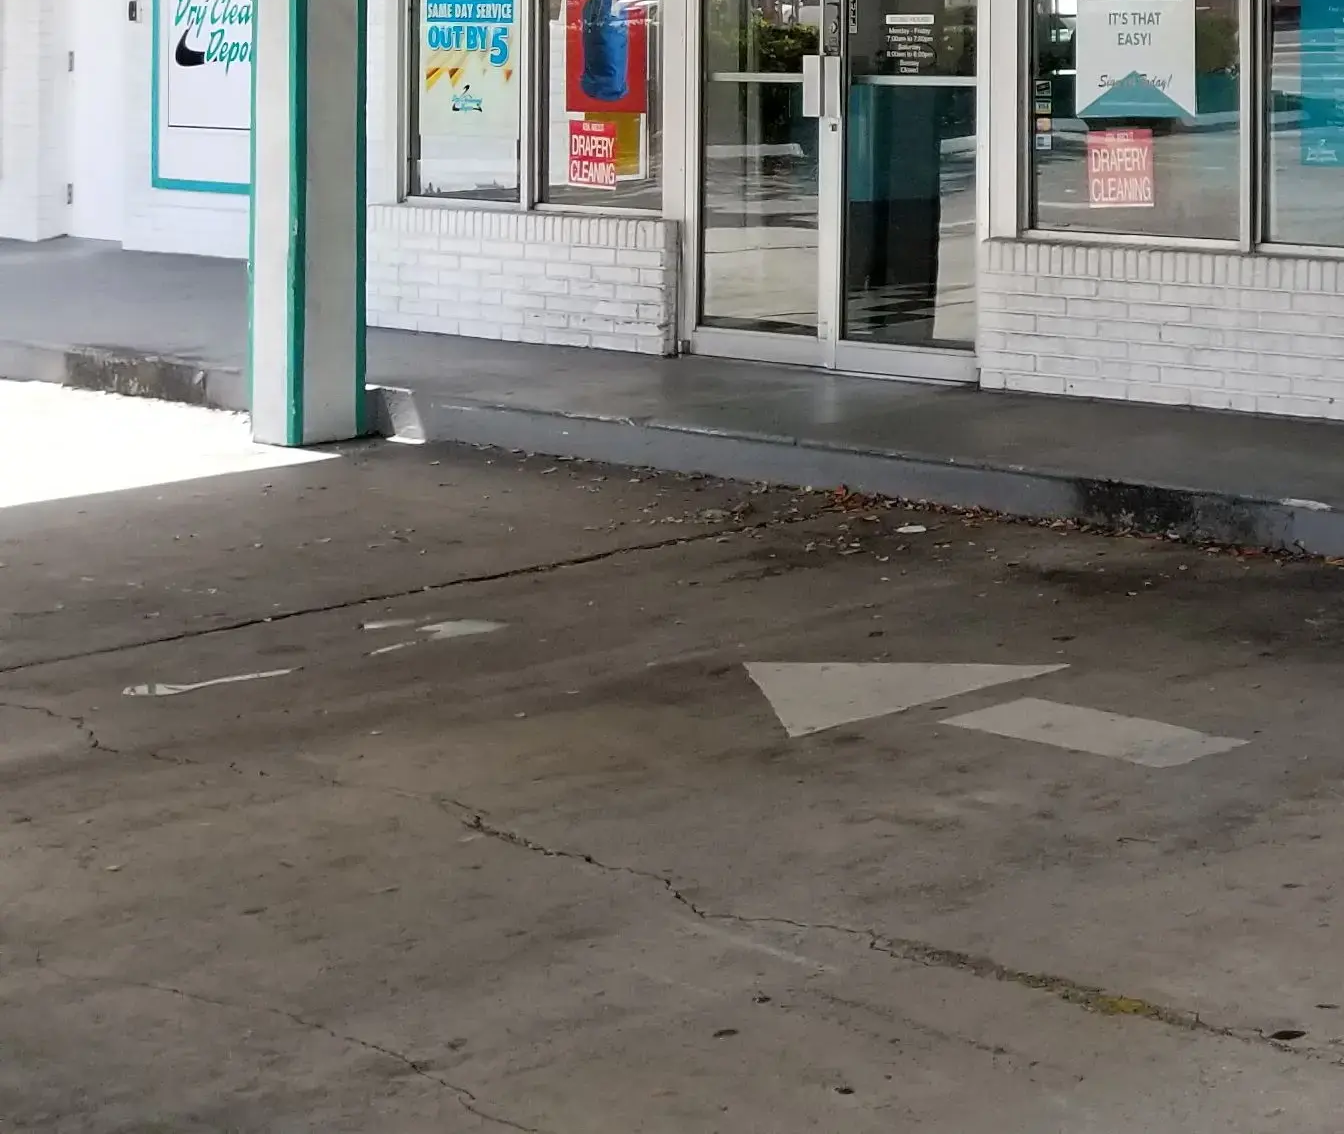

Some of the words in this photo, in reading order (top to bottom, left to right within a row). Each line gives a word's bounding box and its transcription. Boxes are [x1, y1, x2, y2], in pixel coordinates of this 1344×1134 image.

[427, 3, 452, 18] SAME
[454, 3, 472, 18] DAY
[476, 3, 513, 21] SERVICE
[1108, 12, 1128, 26] IT'S
[1131, 12, 1161, 26] THAT
[427, 25, 463, 51] OUT
[466, 25, 488, 50] BY
[489, 26, 510, 66] 5
[1118, 32, 1151, 46] EASY!
[206, 28, 252, 77] Depo
[571, 134, 615, 158] DRAPERY
[1091, 147, 1148, 172] DRAPERY
[570, 160, 615, 184] CLEANING
[1091, 176, 1151, 202] CLEANING
